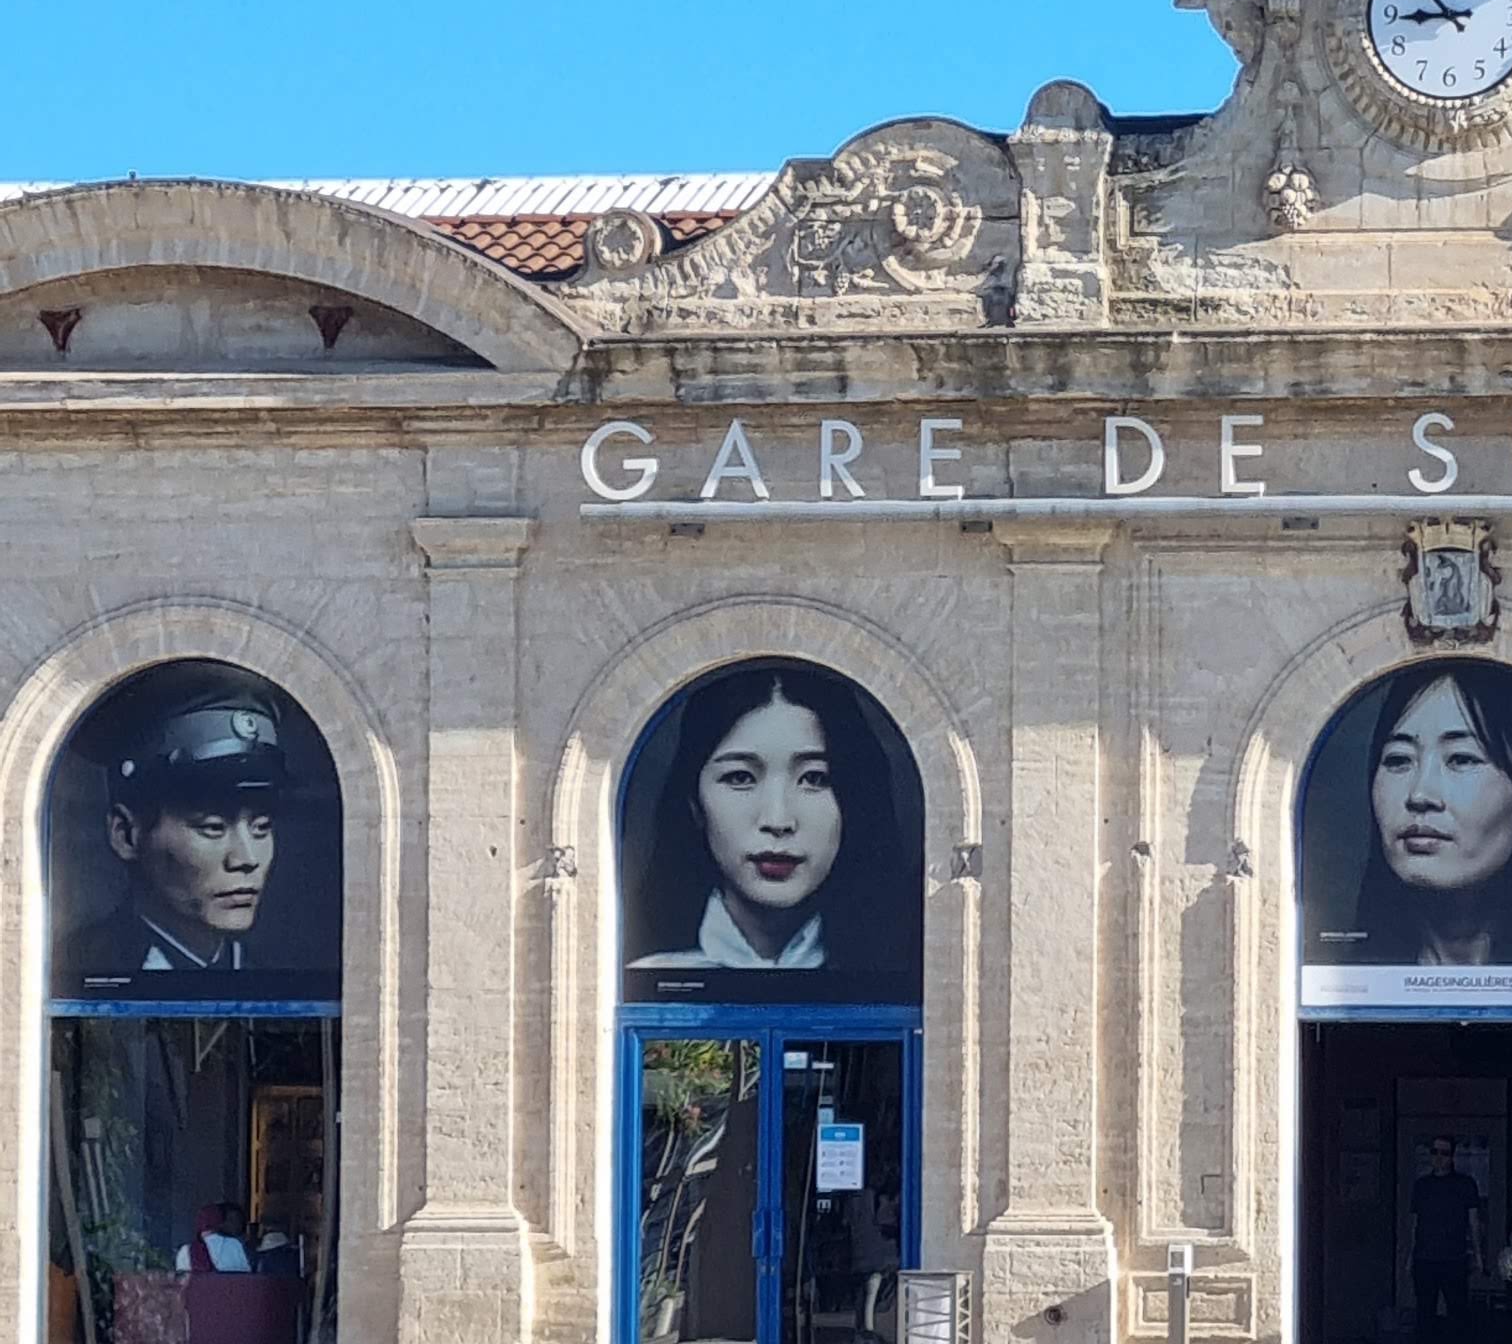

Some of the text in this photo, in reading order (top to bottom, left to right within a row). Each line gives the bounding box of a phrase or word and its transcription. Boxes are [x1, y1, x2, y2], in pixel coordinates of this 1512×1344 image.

[1384, 4, 1398, 24] 9
[1391, 35, 1406, 56] 8
[1493, 37, 1507, 59] 4
[1416, 60, 1428, 81] 7
[1442, 67, 1456, 87] 6
[1473, 60, 1485, 80] 5
[581, 417, 964, 501] GARE
[1105, 415, 1265, 495] DE
